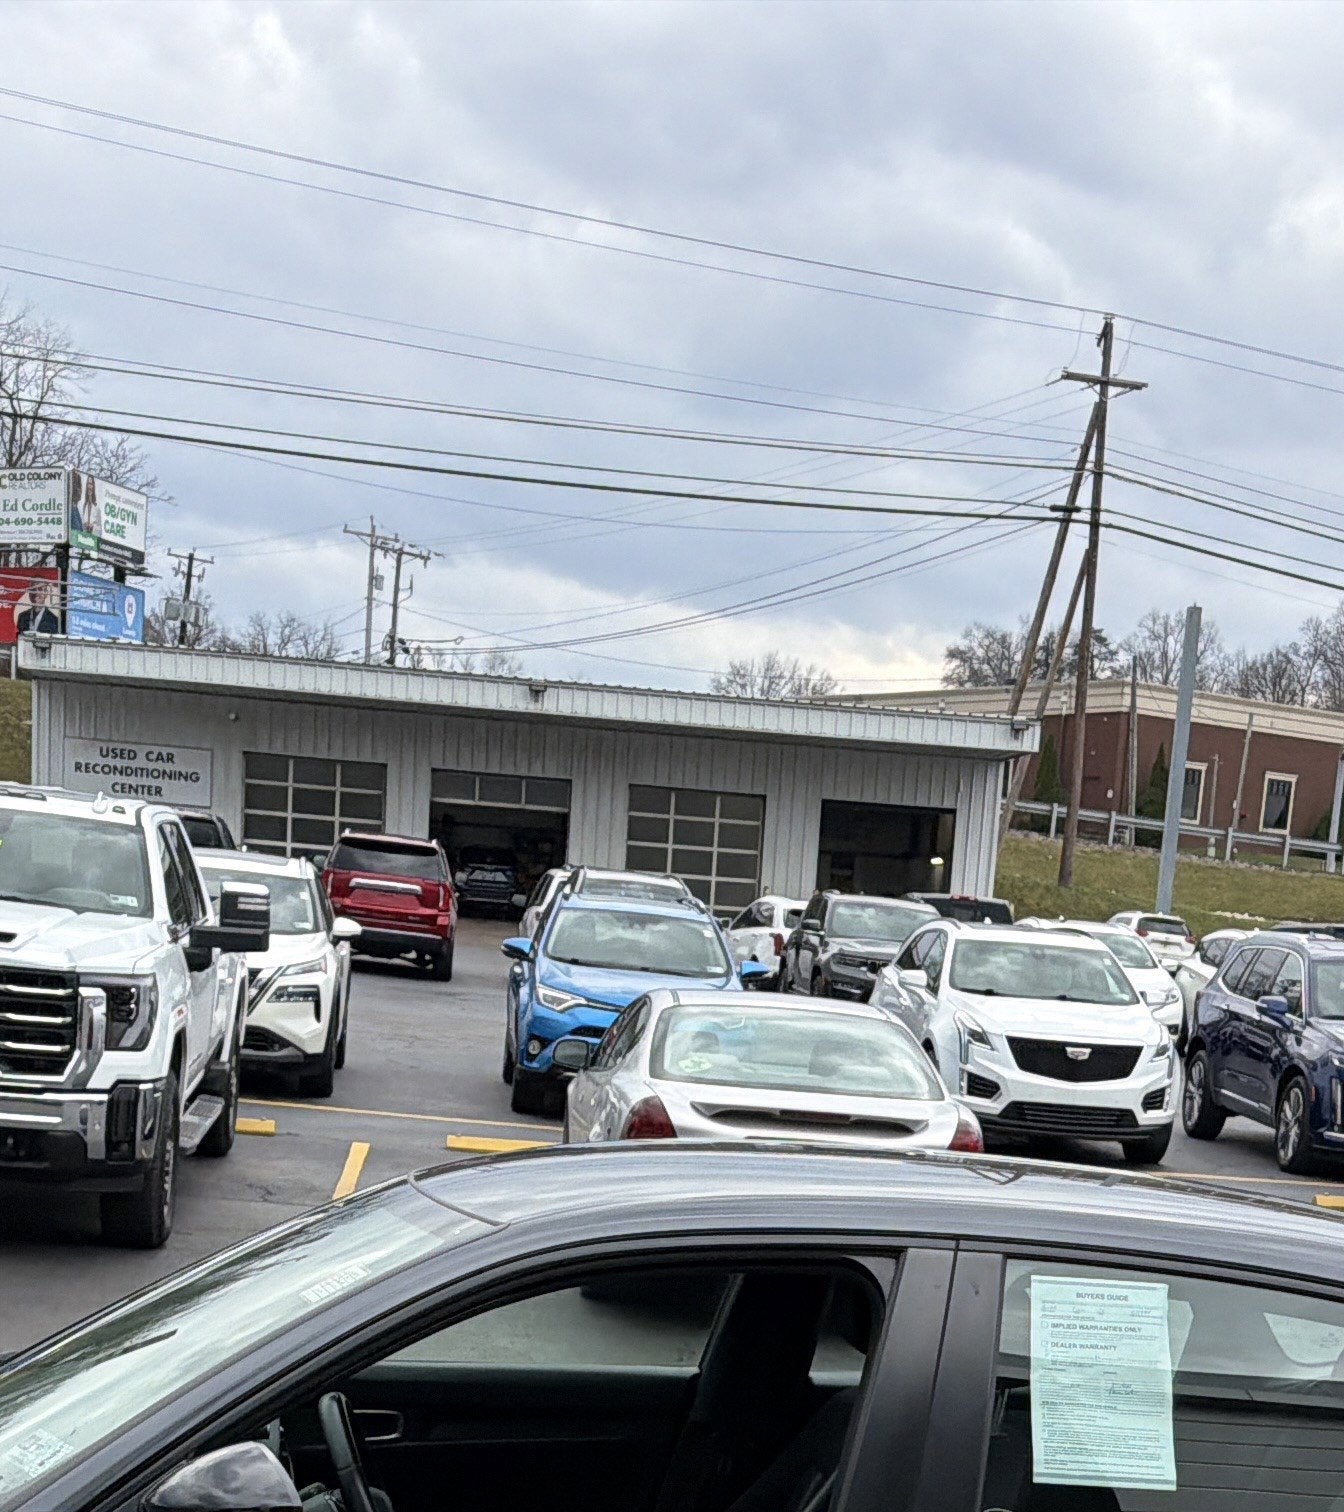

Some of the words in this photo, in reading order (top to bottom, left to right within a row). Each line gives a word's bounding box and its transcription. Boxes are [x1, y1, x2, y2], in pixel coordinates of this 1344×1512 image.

[8, 472, 26, 482] OLD
[27, 471, 62, 481] COLONY
[8, 481, 46, 490] REALTORS
[2, 498, 18, 512] Ed
[104, 501, 138, 526] OB/GYN
[103, 519, 127, 539] CARE
[99, 745, 138, 761] USED
[145, 750, 175, 765] CAR
[74, 761, 201, 783] RECONDITIONING
[111, 781, 163, 797] CENTER
[1076, 1292, 1105, 1301] BUYERS
[1050, 1322, 1077, 1330] IMPLIED
[1078, 1324, 1123, 1333] WARRANTIES
[1050, 1341, 1077, 1349] DEALER
[1078, 1343, 1118, 1351] WARRANTY
